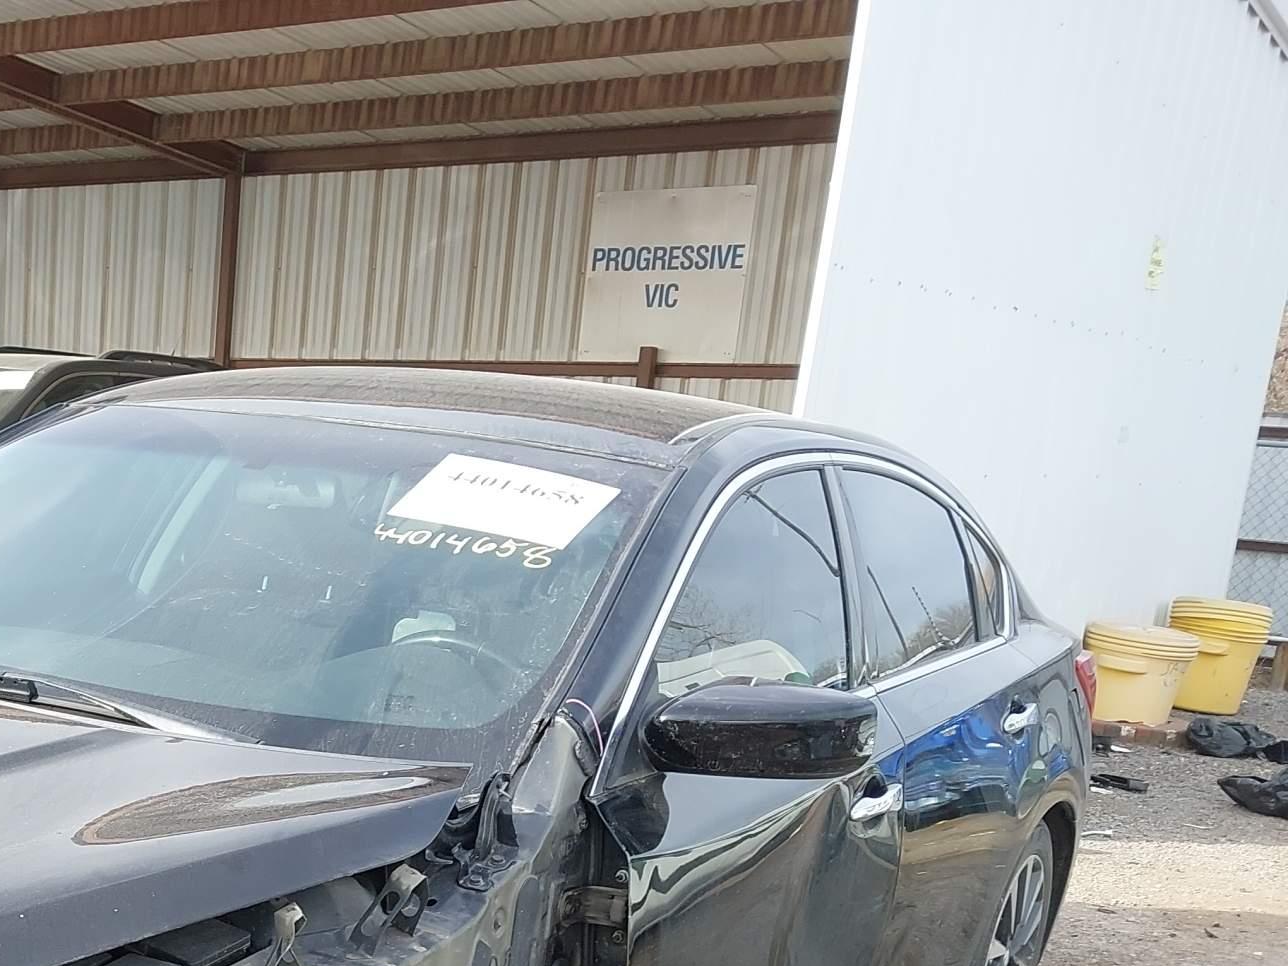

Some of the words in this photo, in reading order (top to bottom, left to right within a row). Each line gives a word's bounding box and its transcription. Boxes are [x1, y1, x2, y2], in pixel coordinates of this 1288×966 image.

[591, 244, 746, 271] PROGRESSIVE
[644, 283, 679, 308] VIC
[373, 523, 558, 569] 44014658
